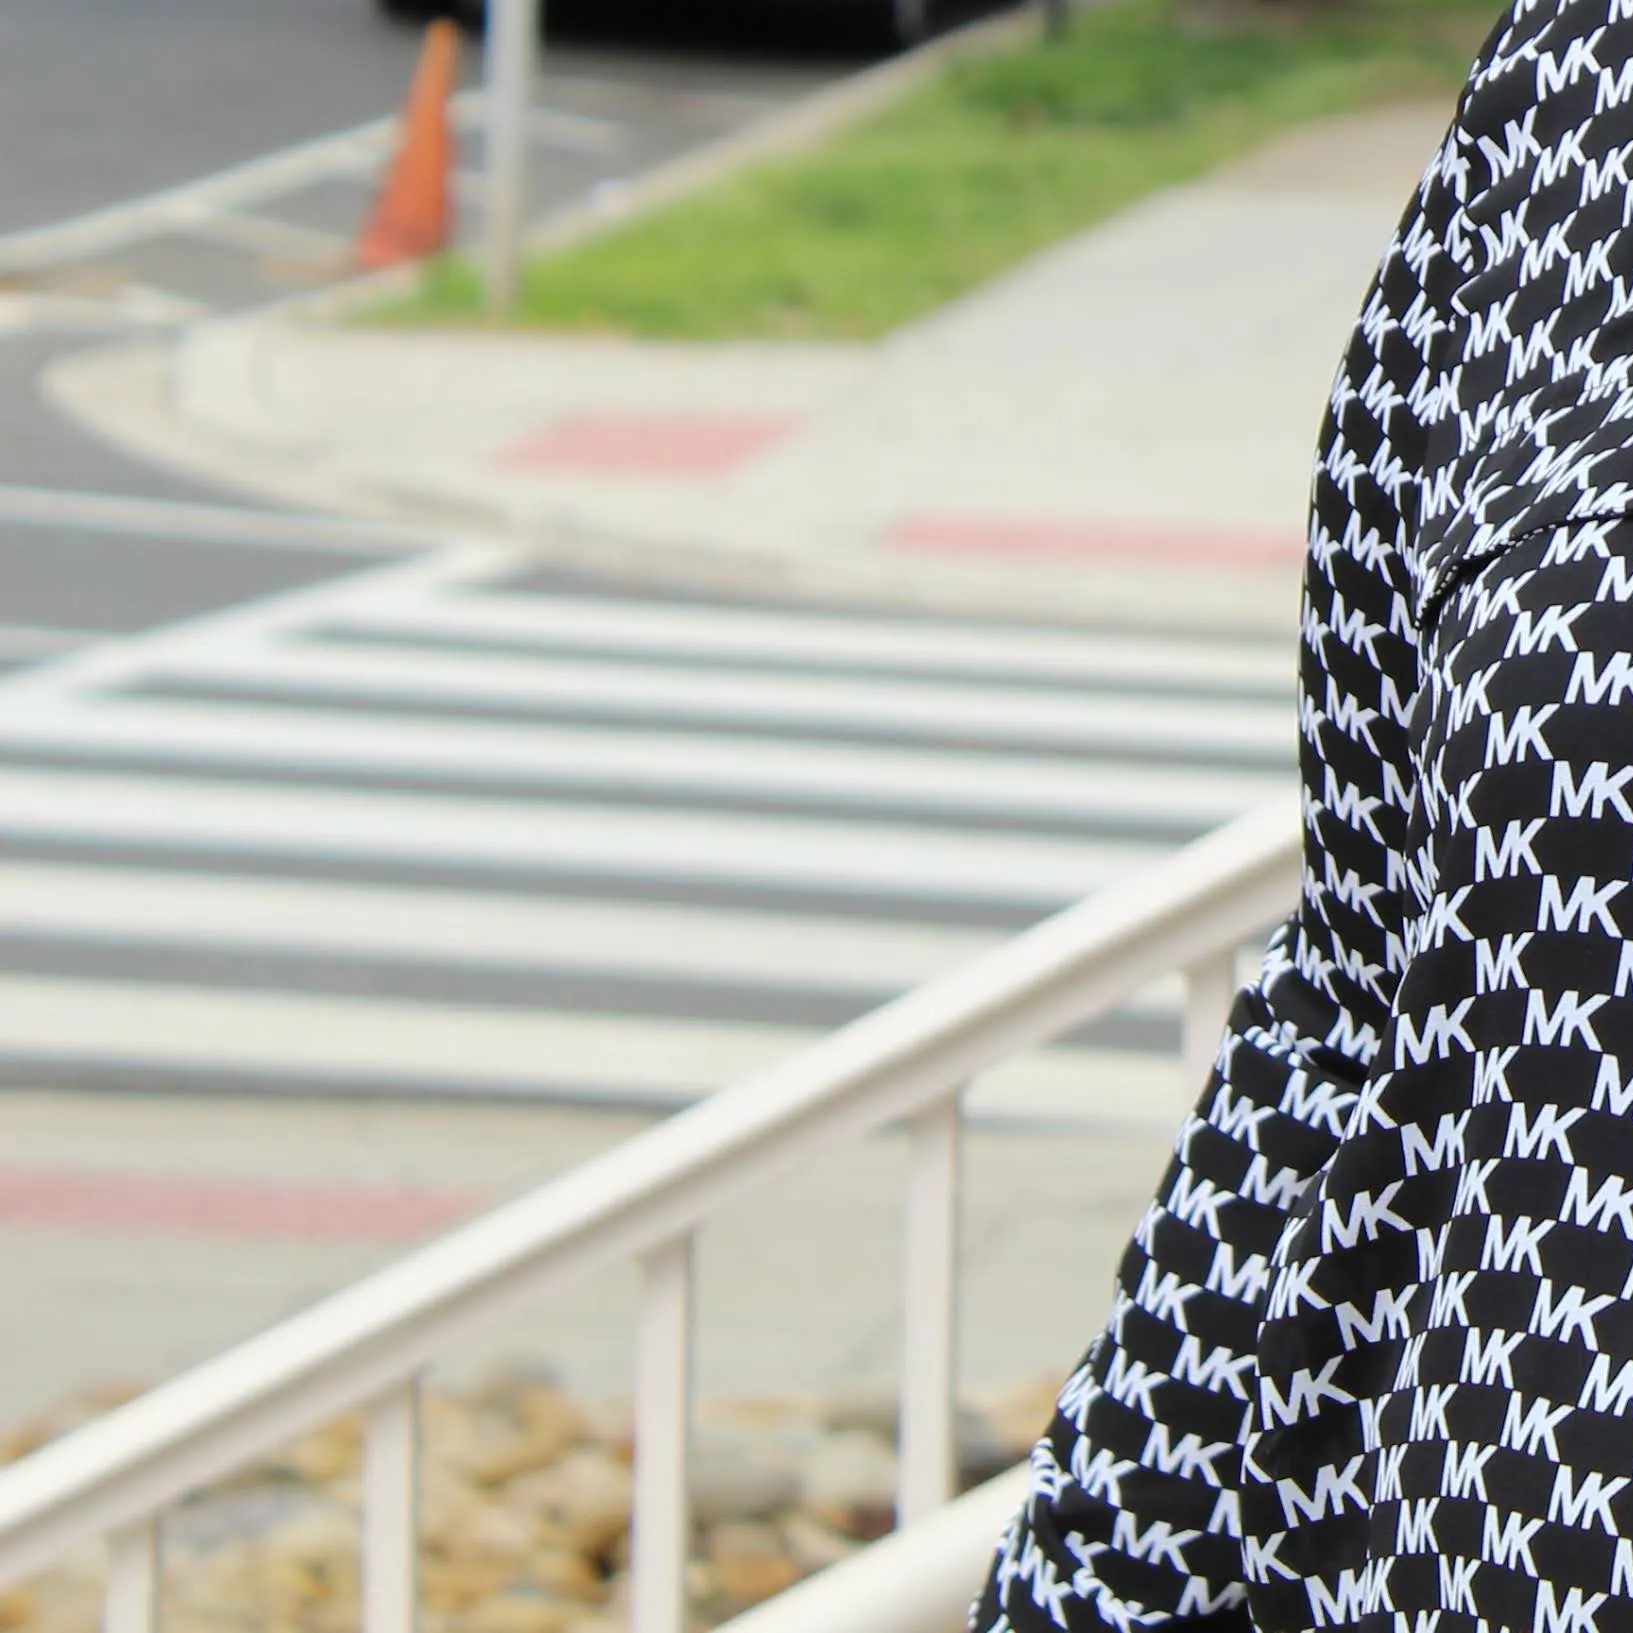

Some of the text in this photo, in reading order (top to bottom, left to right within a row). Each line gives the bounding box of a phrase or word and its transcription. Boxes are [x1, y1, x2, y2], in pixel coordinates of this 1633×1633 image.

[1502, 602, 1592, 660] MK
[1484, 703, 1560, 770] MK
[1475, 818, 1547, 883] MK
[1537, 874, 1629, 938] MK
[1522, 988, 1611, 1052] MK
[1502, 1102, 1588, 1165] MK
[1166, 1166, 1236, 1240] MK
[1480, 1214, 1557, 1276] MK
[1135, 1258, 1202, 1332] MK
[1528, 1278, 1617, 1352] MK
[1459, 1326, 1527, 1390] MK
[1140, 1422, 1232, 1488] MK
[1499, 1390, 1576, 1463] MK
[1548, 1464, 1631, 1536] MK
[1482, 1504, 1546, 1578] MK
